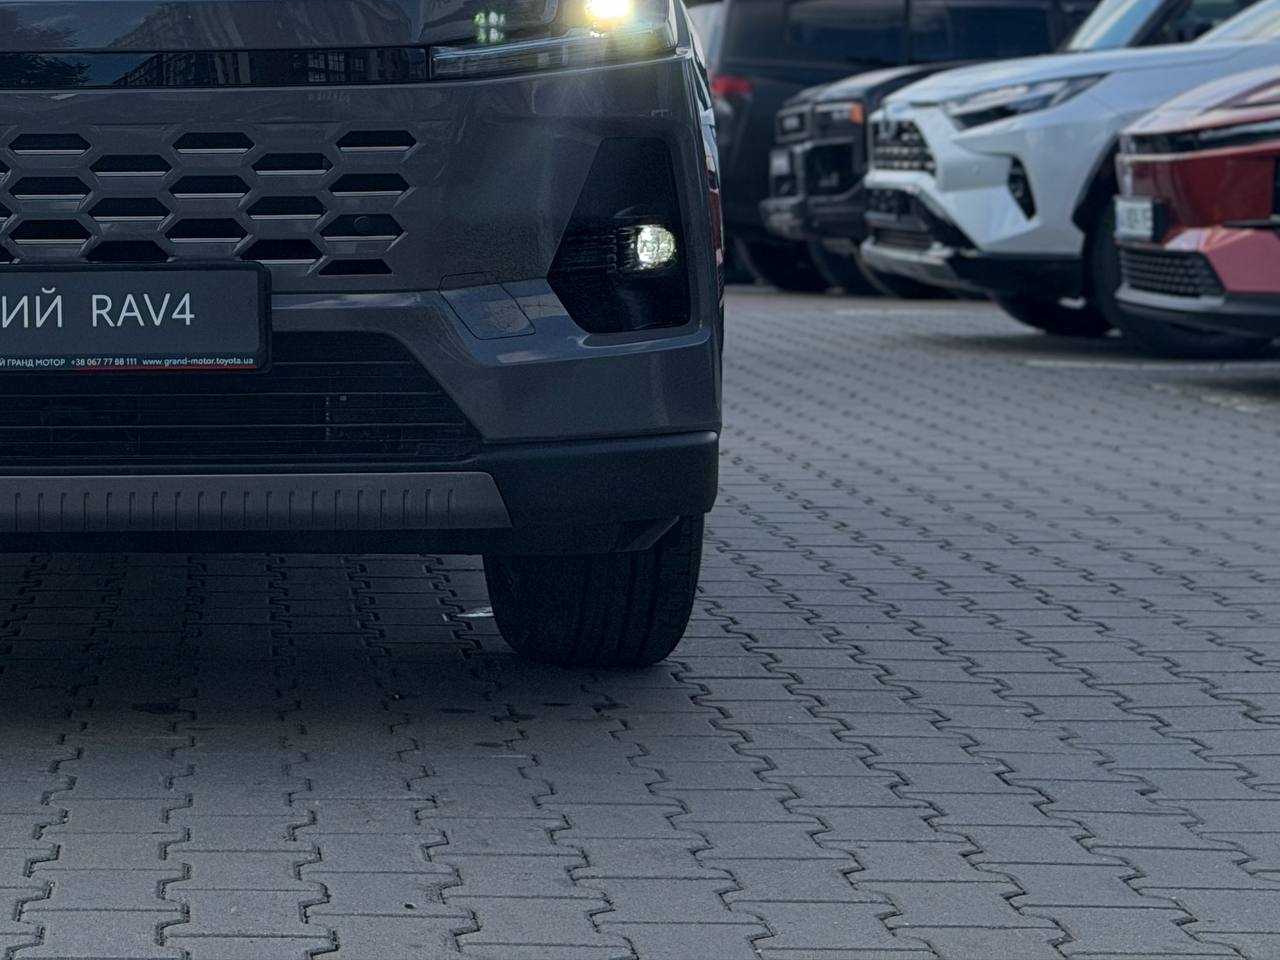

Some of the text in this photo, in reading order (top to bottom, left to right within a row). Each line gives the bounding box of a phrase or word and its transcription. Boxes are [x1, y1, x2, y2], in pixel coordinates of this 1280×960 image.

[91, 293, 195, 328] RAV4
[7, 359, 34, 368] ГРАНД
[35, 359, 65, 367] МОТОР
[71, 358, 85, 366] +38
[86, 358, 102, 366] 067
[103, 358, 113, 366] 77
[126, 358, 137, 366] 111
[142, 357, 253, 367] www.grand-motor.toyota.ua
